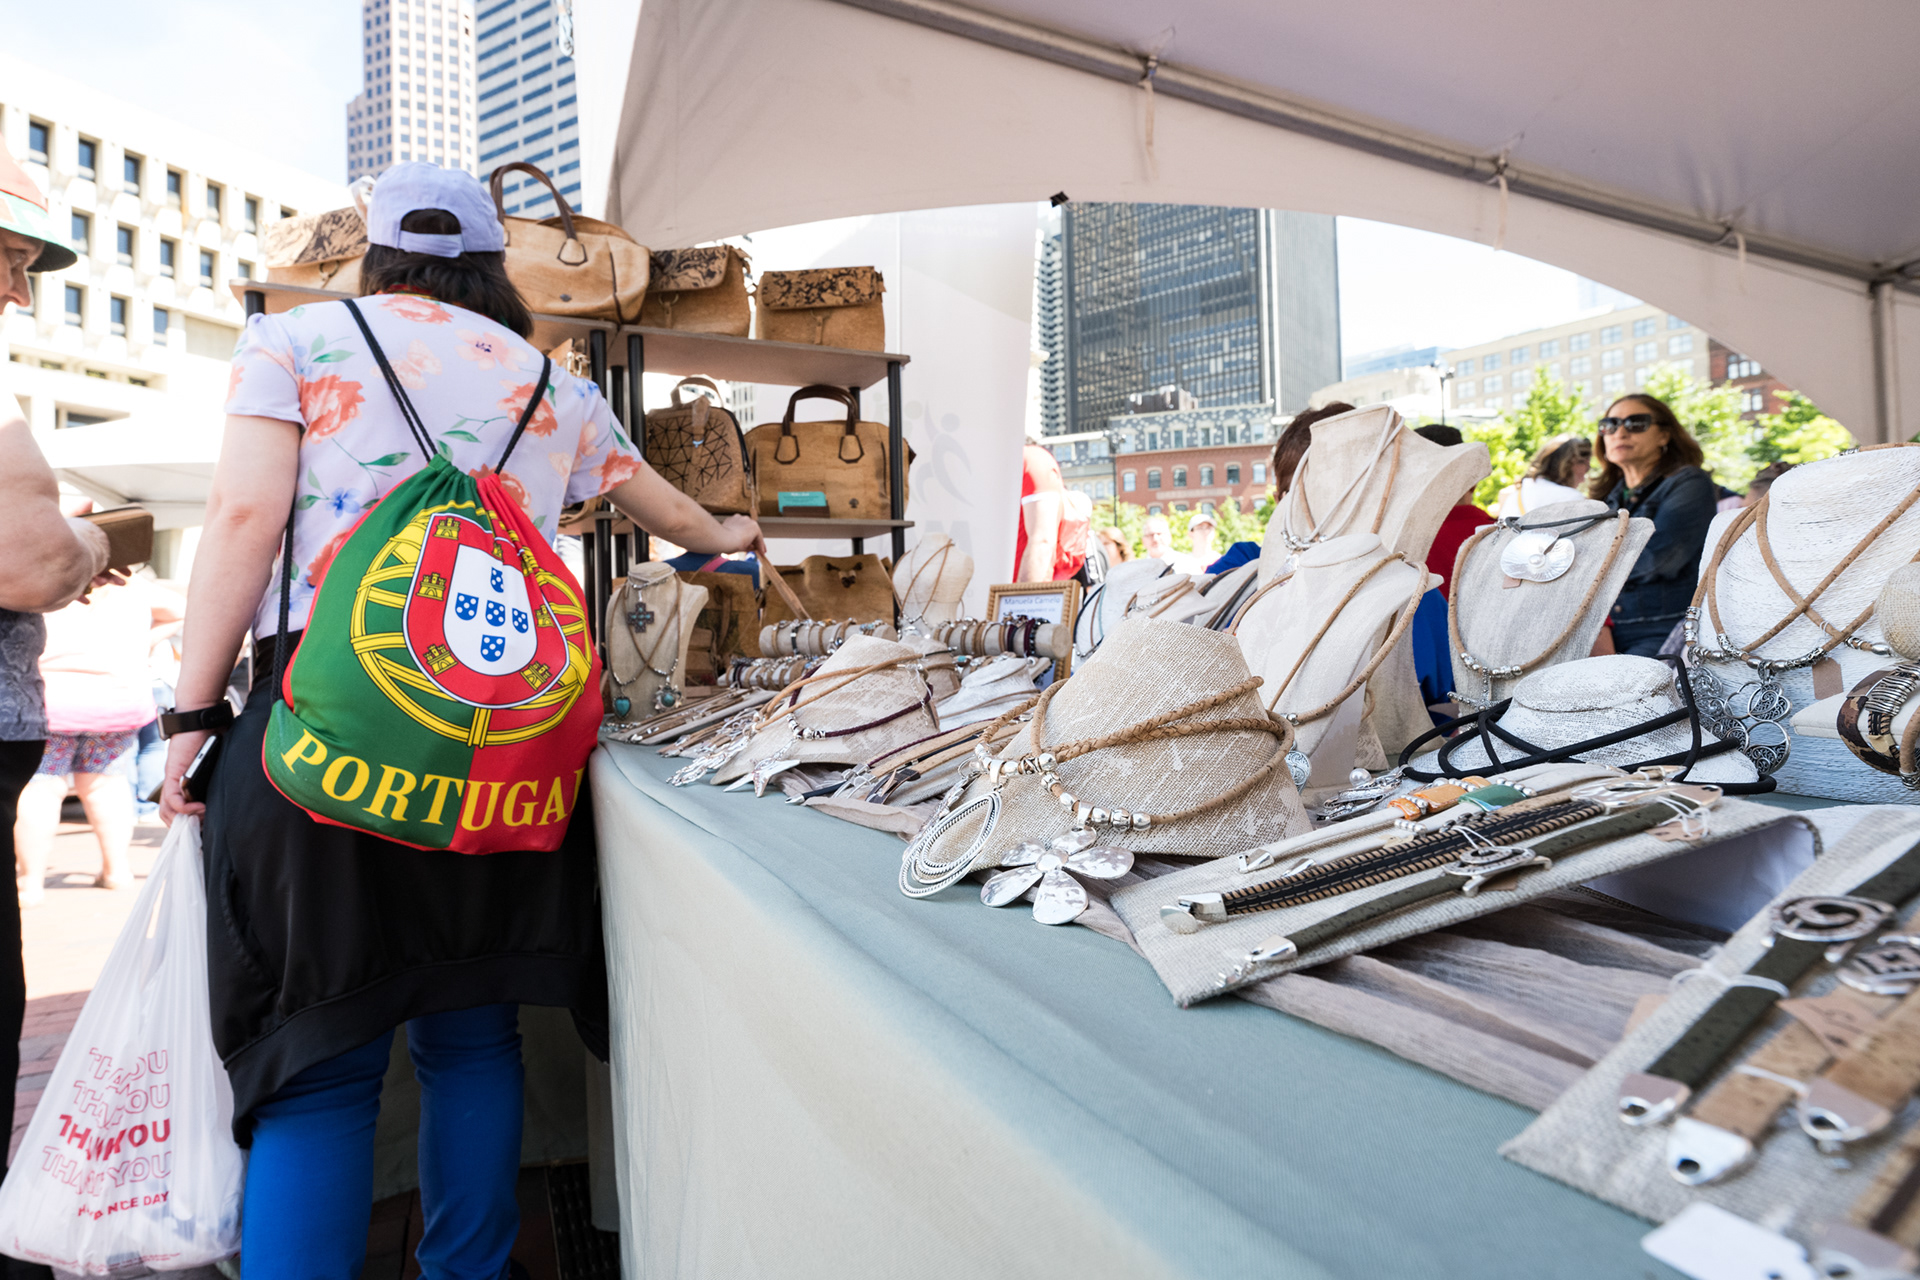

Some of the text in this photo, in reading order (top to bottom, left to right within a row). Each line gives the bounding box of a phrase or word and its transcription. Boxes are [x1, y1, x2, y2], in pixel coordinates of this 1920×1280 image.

[1005, 597, 1033, 605] Manuela
[107, 1151, 172, 1188] YOU
[108, 1197, 139, 1215] NCE
[143, 1191, 170, 1206] DAY
